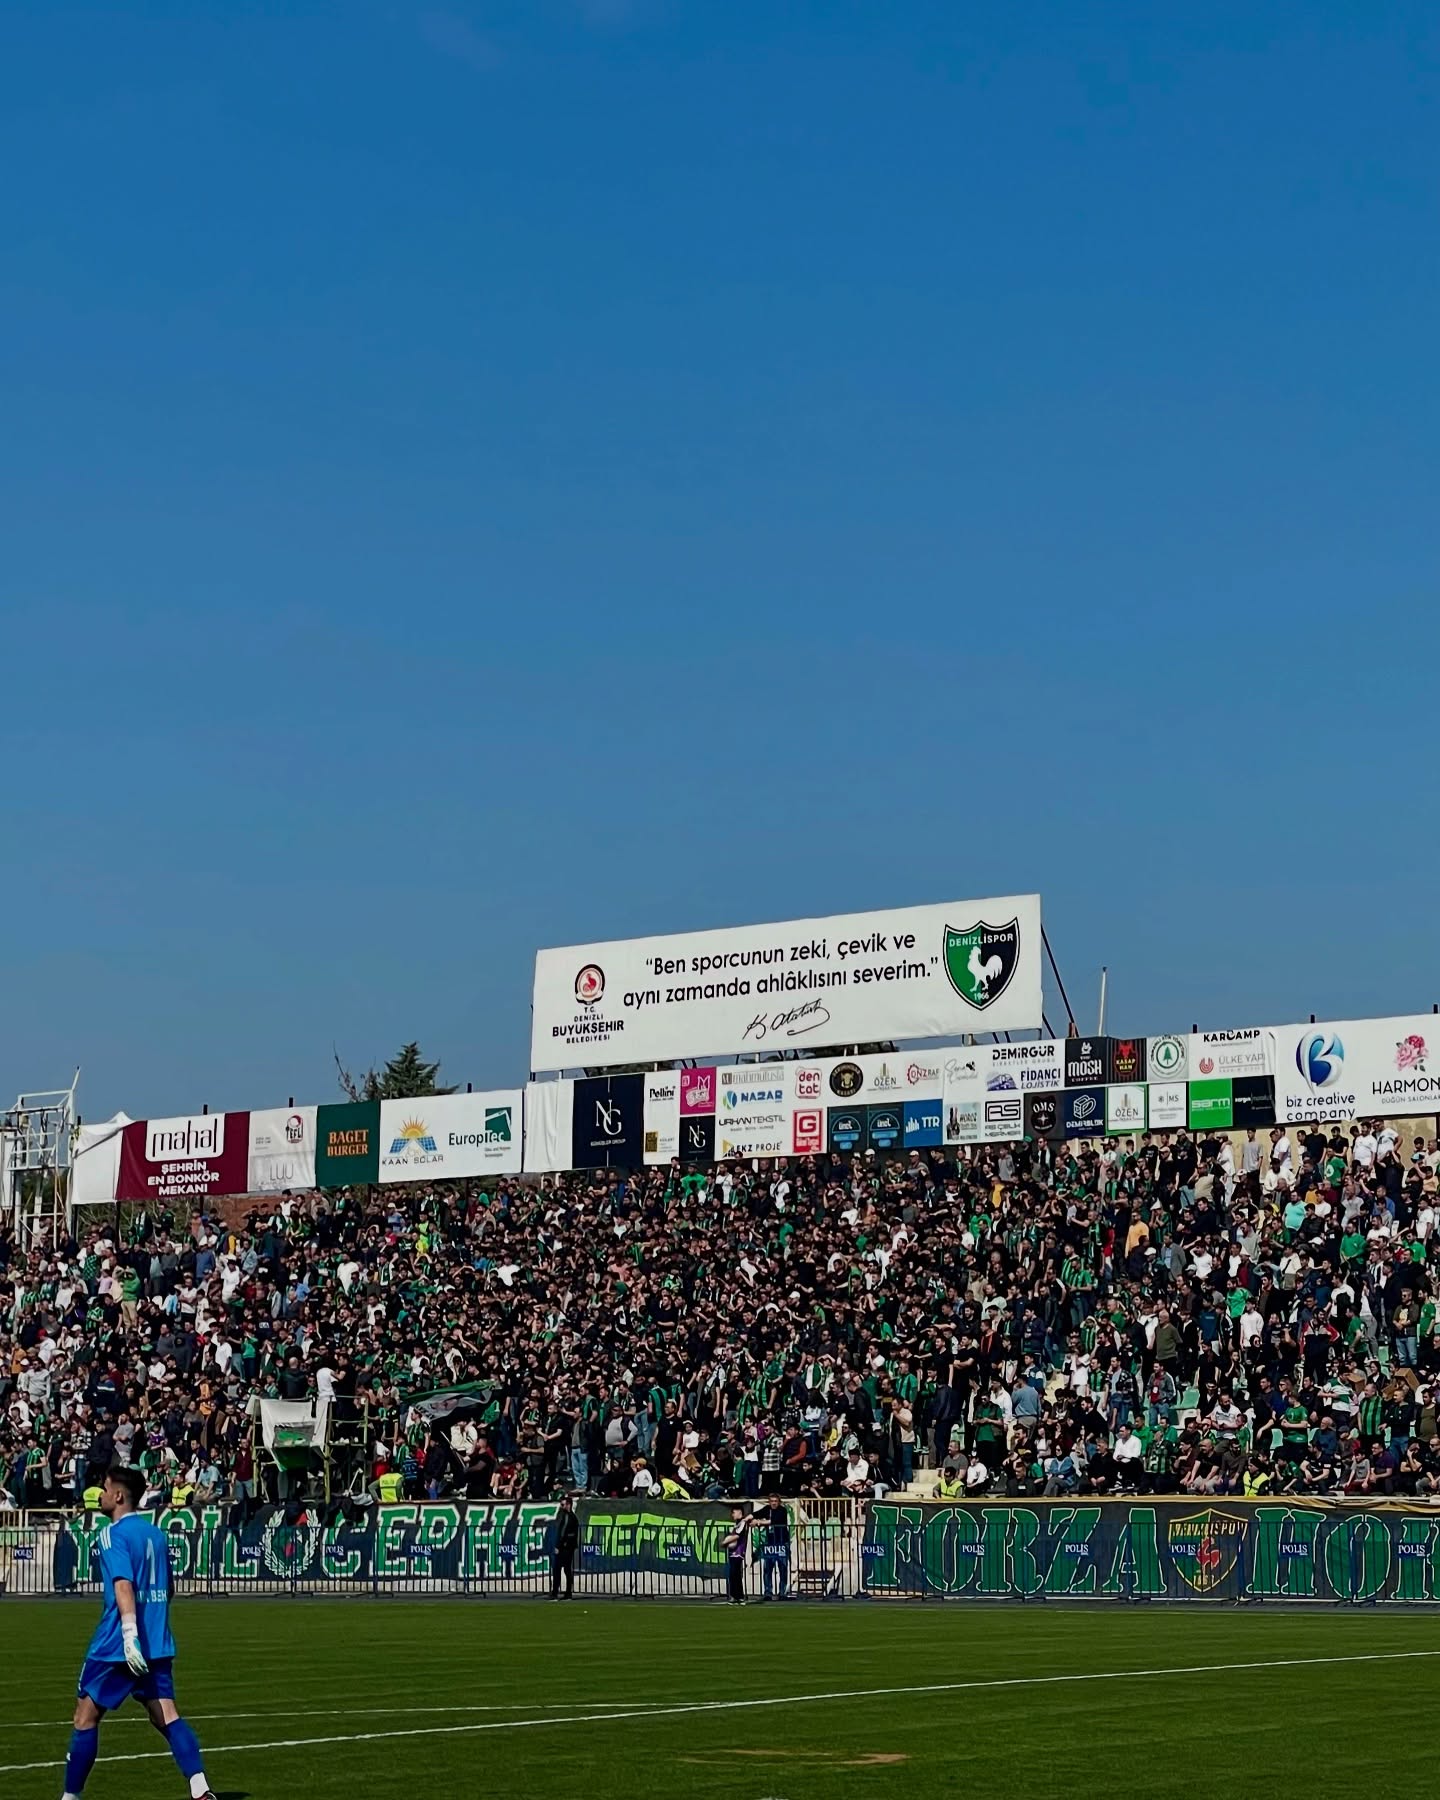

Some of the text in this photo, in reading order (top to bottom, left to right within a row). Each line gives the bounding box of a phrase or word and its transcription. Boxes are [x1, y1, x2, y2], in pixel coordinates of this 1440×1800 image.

[691, 948, 784, 975] sporcunun
[790, 939, 831, 961] zeki,
[837, 933, 887, 960] çevik
[893, 934, 915, 949] ve
[623, 990, 660, 1010] aynı
[666, 977, 750, 1003] zamanda
[756, 968, 847, 993] ahlâklısını
[974, 991, 989, 1001] 1966
[1021, 1067, 1060, 1081] FİDANCI
[1068, 1059, 1102, 1077] MOSH
[1286, 1096, 1302, 1107] biz
[1306, 1092, 1355, 1106] creative
[1287, 1108, 1355, 1121] company
[152, 1118, 218, 1157] mahal
[329, 1129, 369, 1144] BAGET
[327, 1144, 369, 1156] BURGER
[414, 1155, 444, 1164] SOLAR
[148, 1171, 220, 1186] EN BONKÖR
[322, 1503, 561, 1578] CEPHE
[866, 1504, 1168, 1593] FORZA
[146, 1538, 155, 1584] 1
